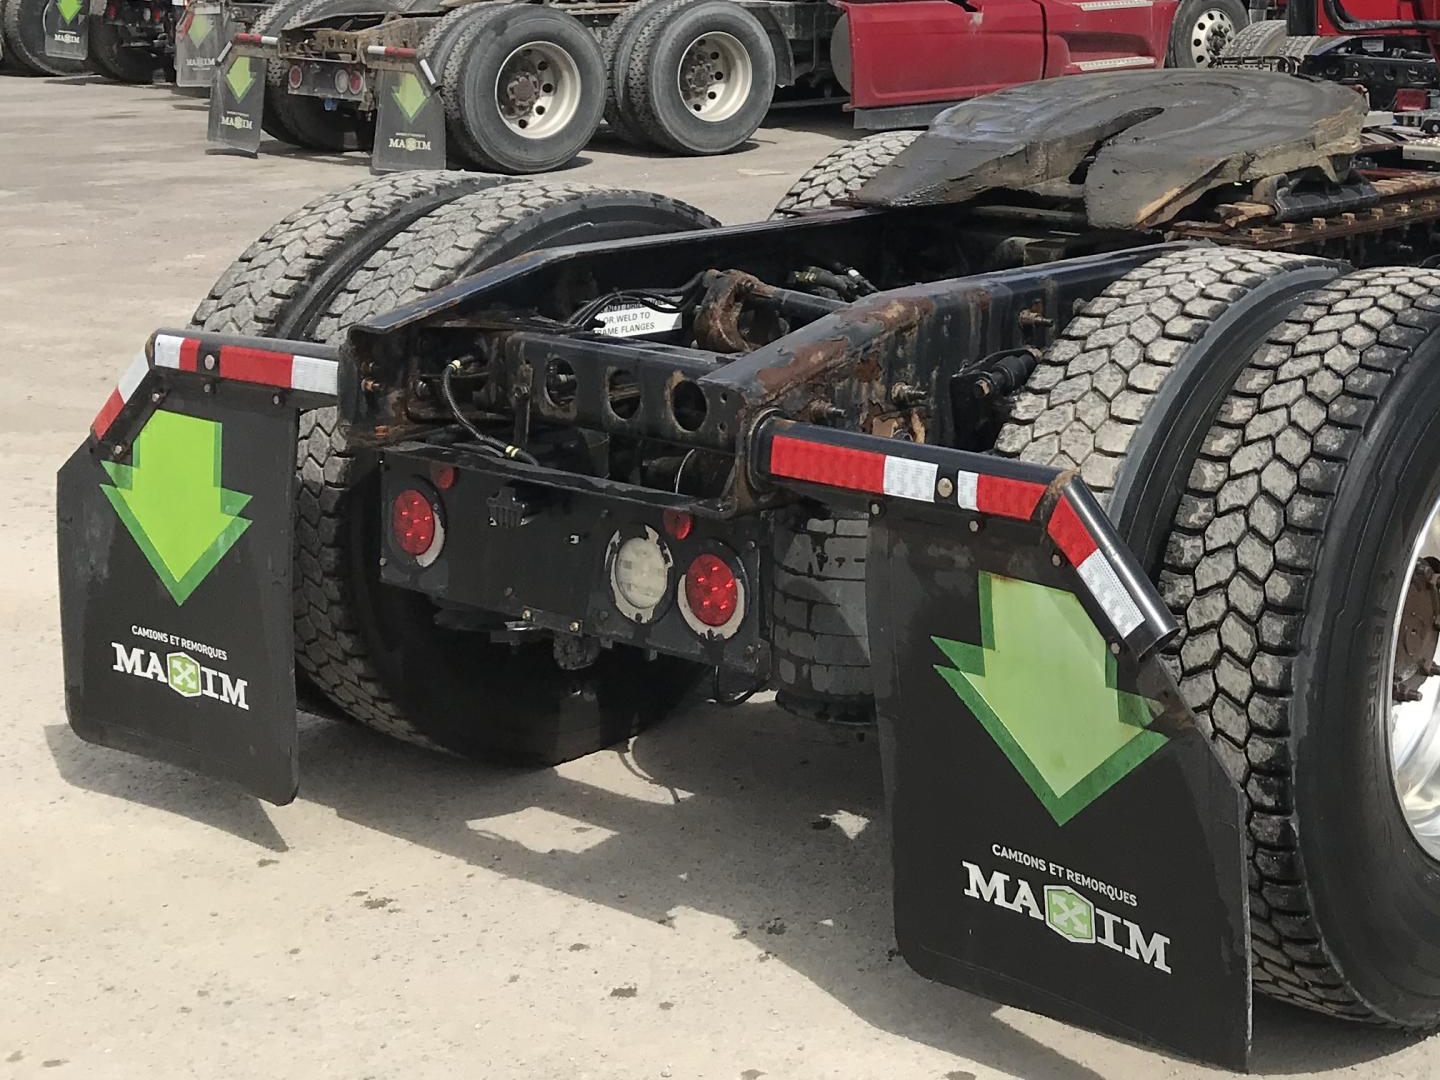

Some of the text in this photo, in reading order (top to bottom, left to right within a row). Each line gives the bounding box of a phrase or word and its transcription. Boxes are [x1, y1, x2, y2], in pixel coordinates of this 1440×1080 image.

[616, 313, 638, 323] WELD
[640, 311, 651, 319] TO
[621, 322, 656, 333] FLANGES
[131, 625, 228, 661] CAMIONS ET REMORQUES
[111, 641, 250, 711] MAXIM
[991, 843, 1138, 907] CAMIONS ET REMORQUES
[962, 860, 1172, 975] MAXIM
